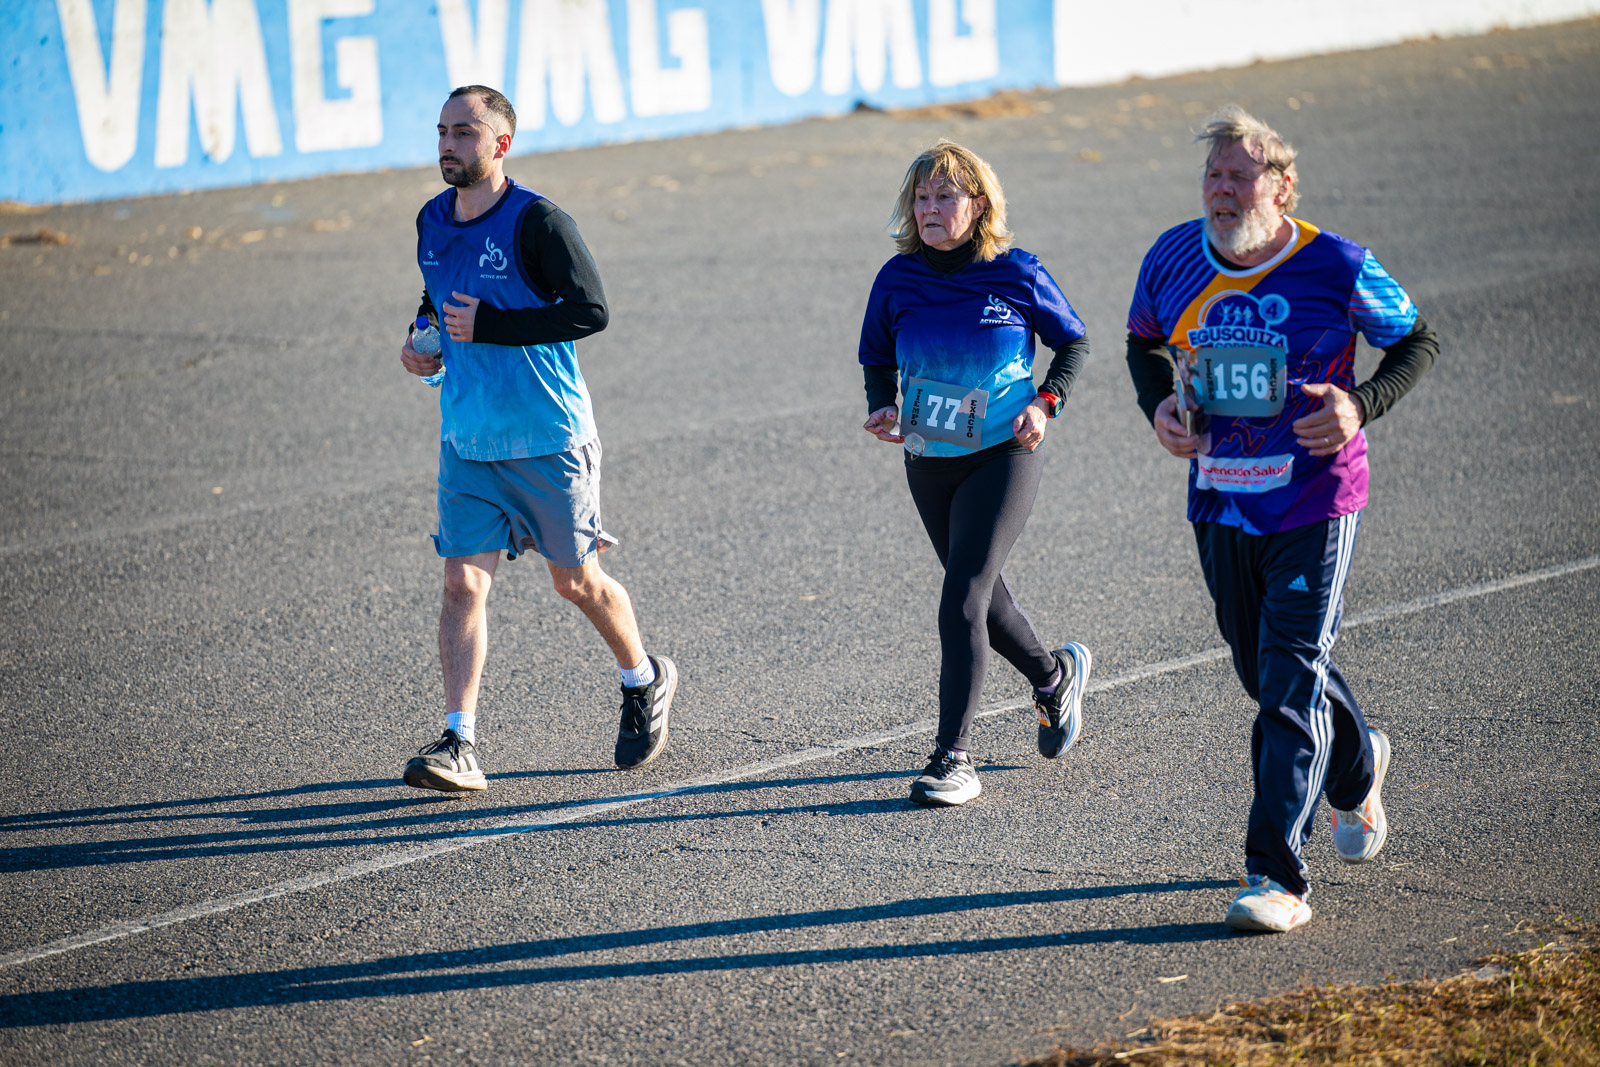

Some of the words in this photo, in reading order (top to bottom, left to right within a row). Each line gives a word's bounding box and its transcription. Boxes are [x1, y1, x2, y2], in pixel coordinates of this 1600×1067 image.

[57, 0, 384, 172] VMG
[1265, 302, 1278, 318] 4
[1189, 327, 1285, 348] EGUSQUIZA
[1204, 358, 1215, 401] TIEMPO
[1214, 363, 1269, 400] 156
[1269, 358, 1278, 402] EXACTO
[910, 388, 923, 426] TIEMPO
[926, 394, 962, 431] 77
[966, 399, 978, 438] EXACTO
[1252, 462, 1288, 477] Salud
